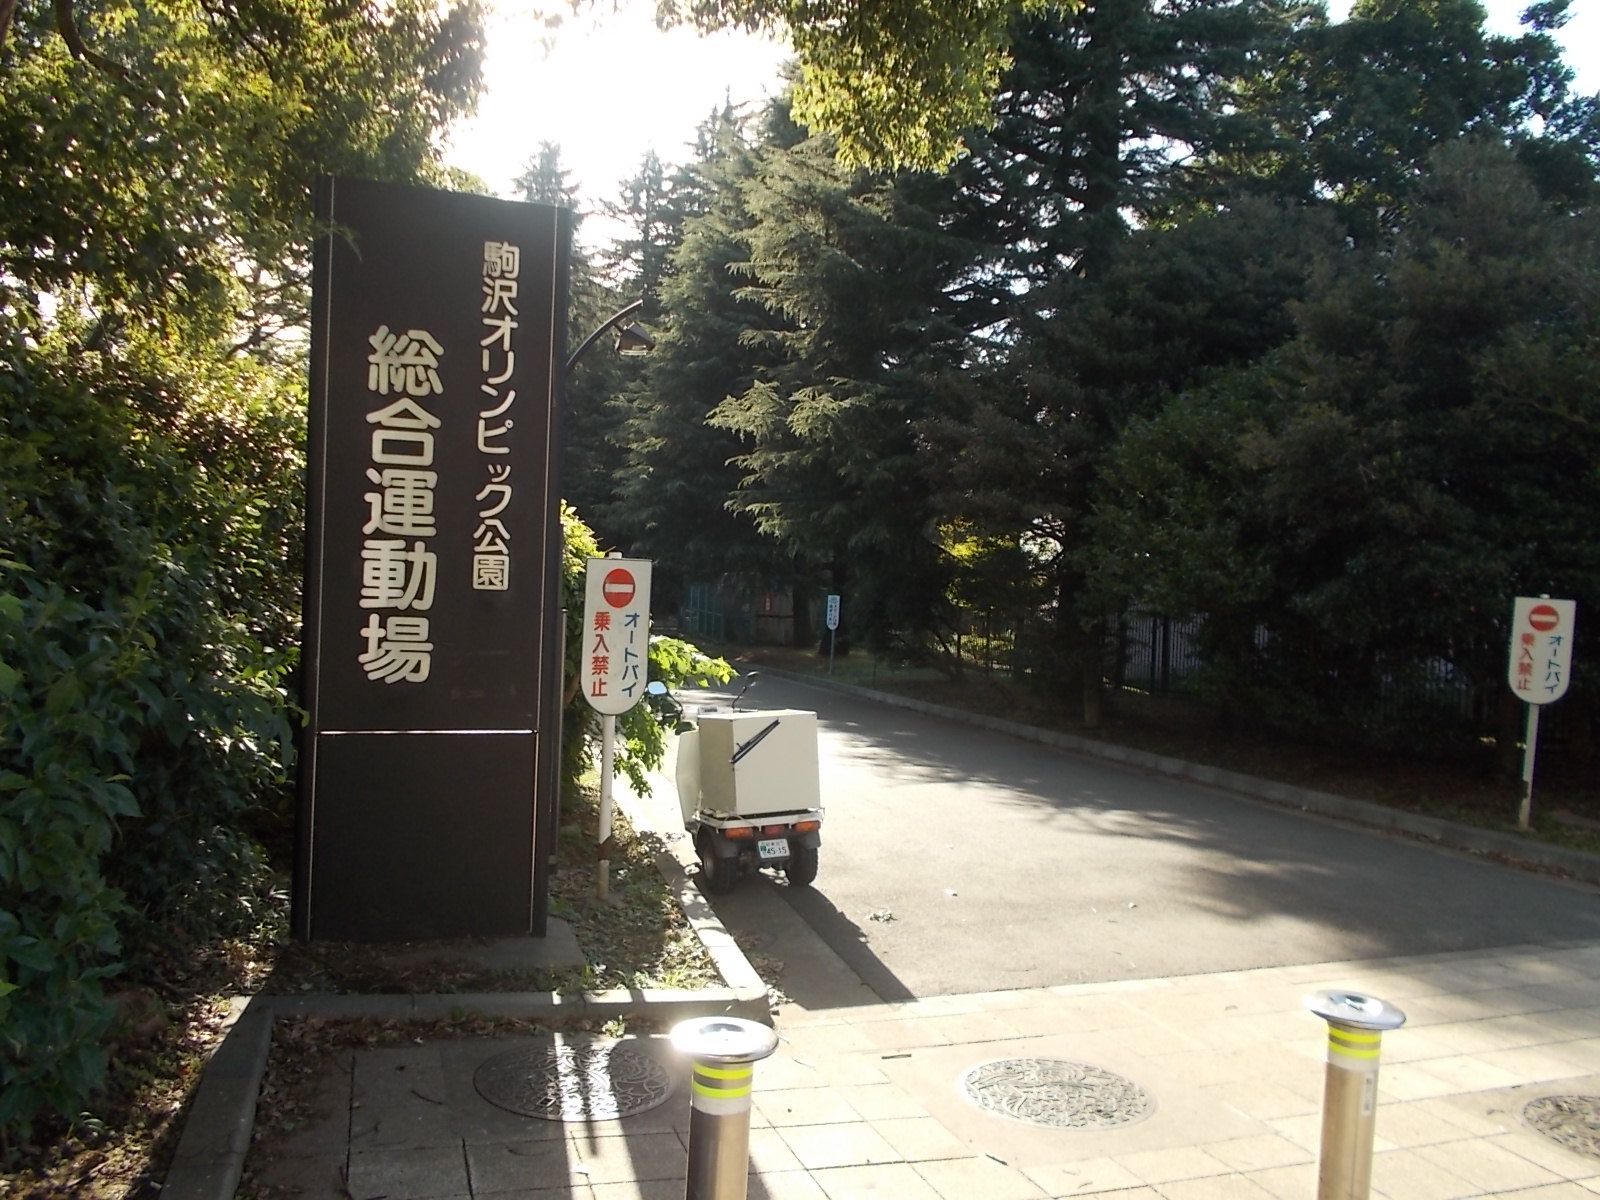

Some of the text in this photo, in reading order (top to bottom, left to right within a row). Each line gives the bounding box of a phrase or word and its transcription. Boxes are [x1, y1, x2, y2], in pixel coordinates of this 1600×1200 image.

[472, 241, 520, 590] 駒沢オリンピック公園
[358, 325, 444, 684] 総合運動場
[590, 612, 611, 697] 乗入禁止
[621, 612, 640, 698] オートバイ
[1544, 635, 1563, 694] オートバイ
